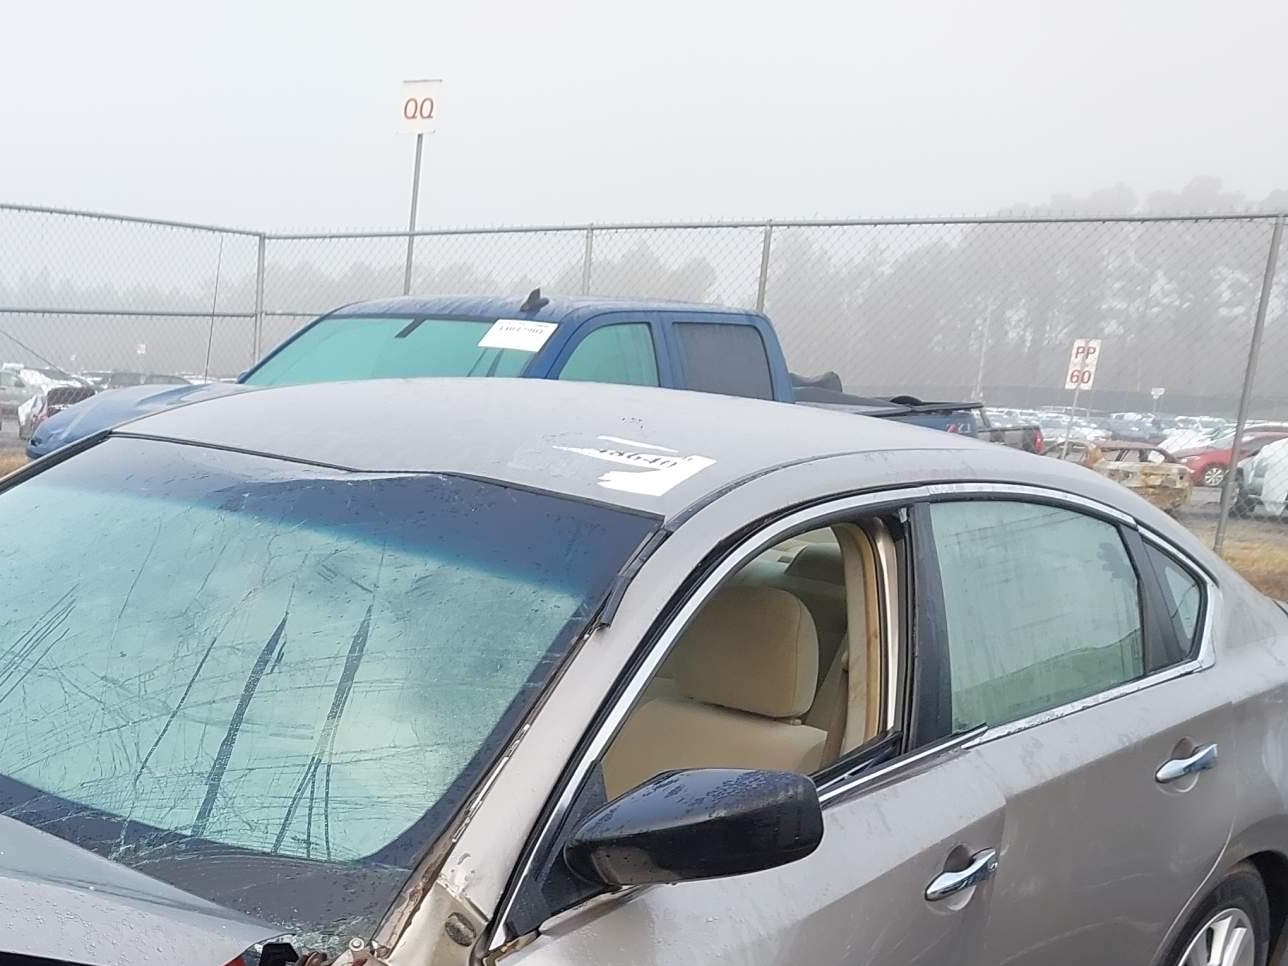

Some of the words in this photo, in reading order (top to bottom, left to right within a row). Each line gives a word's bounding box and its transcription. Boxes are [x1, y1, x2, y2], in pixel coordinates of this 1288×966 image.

[404, 97, 434, 119] QQ
[1075, 346, 1097, 359] PP
[1070, 369, 1092, 384] 60
